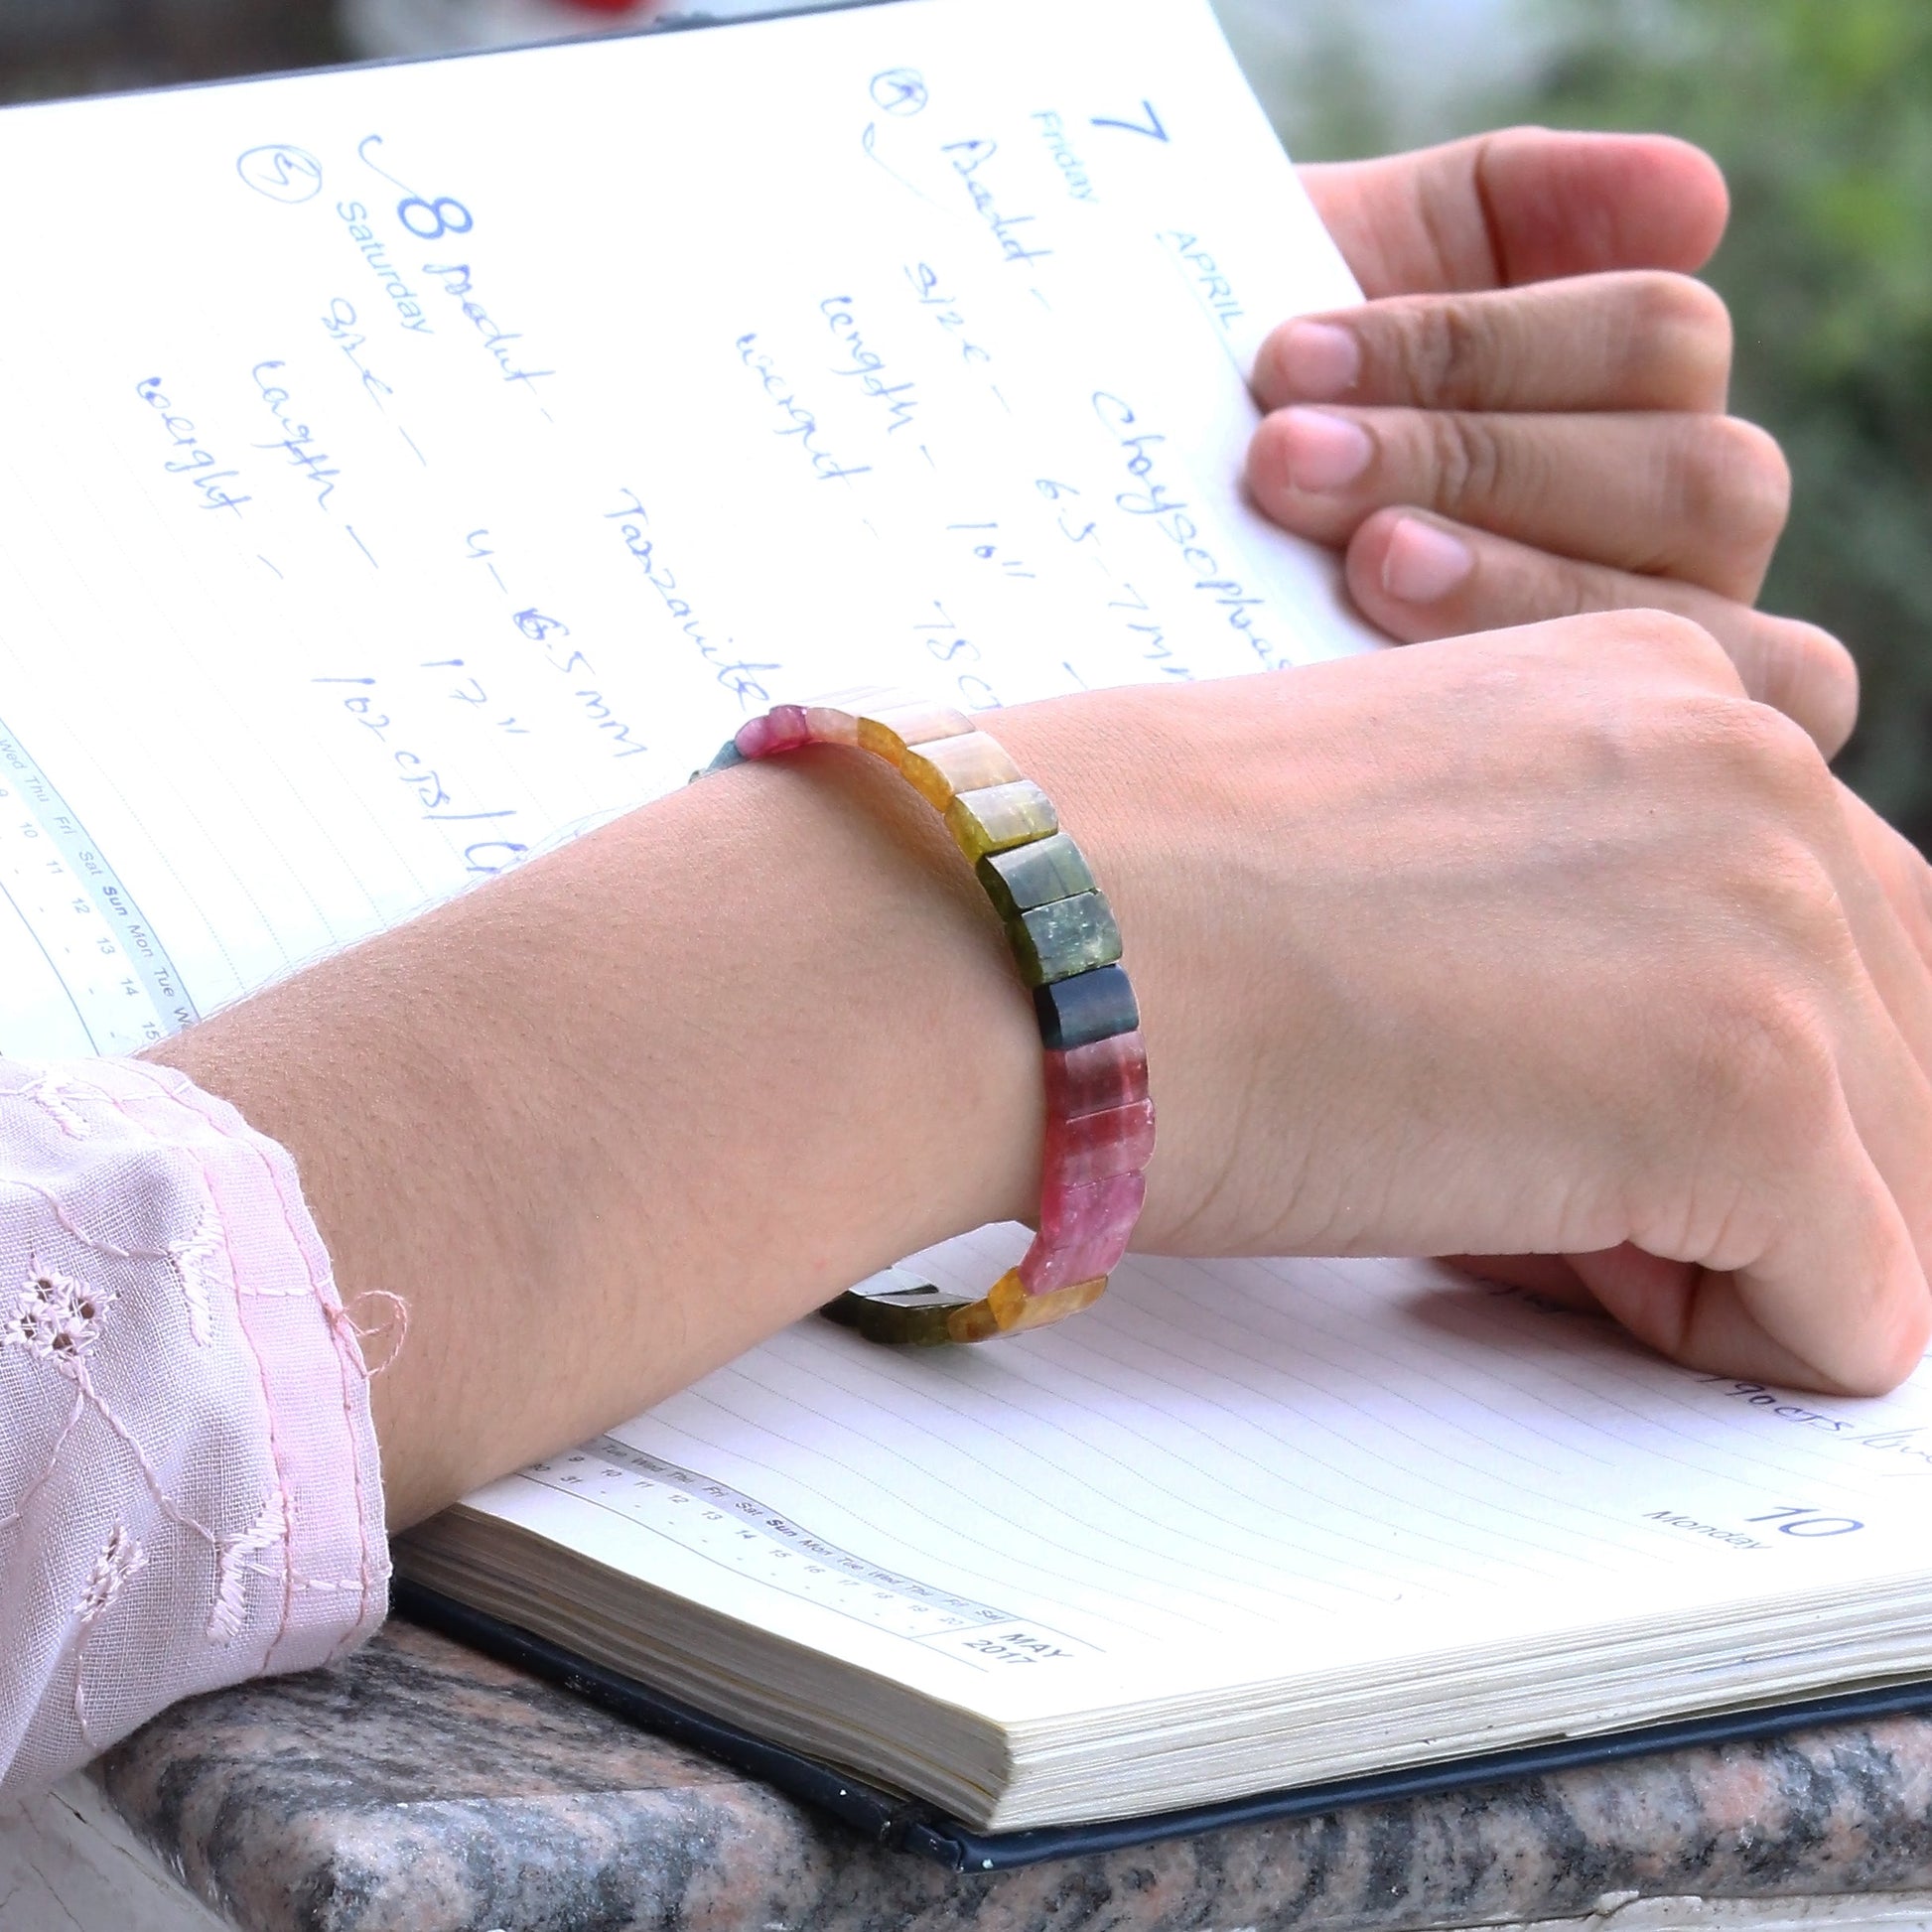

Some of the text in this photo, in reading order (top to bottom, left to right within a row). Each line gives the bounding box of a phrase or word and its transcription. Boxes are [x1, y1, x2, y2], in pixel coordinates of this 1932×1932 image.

[1090, 99, 1171, 144] 7
[1030, 109, 1097, 205] Friday
[397, 197, 474, 239] 8
[337, 202, 435, 334] Saturday
[1168, 229, 1246, 330] APRIL
[0, 740, 28, 769] Wed
[25, 774, 50, 803] Thu
[54, 816, 77, 835] Fri
[78, 851, 103, 876] Sat
[103, 886, 128, 916] Sun
[127, 924, 154, 958] Mon
[154, 967, 175, 998] Tue
[20, 822, 39, 839] 10
[46, 861, 64, 874] 11
[71, 897, 90, 914] 12
[96, 937, 115, 955] 13
[120, 977, 140, 997] 14
[142, 1021, 160, 1039] 15
[560, 1475, 584, 1484] 31
[601, 1468, 622, 1478] 10
[633, 1480, 655, 1489] 11
[667, 1494, 690, 1504] 12
[701, 1510, 723, 1521] 13
[735, 1530, 758, 1540] 14
[768, 1549, 793, 1560] 15
[803, 1565, 826, 1574] 16
[602, 1445, 627, 1458] Tue
[630, 1457, 666, 1473] Wed
[667, 1470, 695, 1484] Thu
[701, 1485, 730, 1499] Fri
[735, 1501, 763, 1517] Sat
[766, 1519, 797, 1538] Sun
[798, 1539, 834, 1557] Mon
[837, 1557, 865, 1572] Tue
[868, 1571, 903, 1585] Wed
[1642, 1510, 1773, 1550] Monday
[1744, 1506, 1864, 1538] 10
[961, 1639, 1038, 1664] 2017
[999, 1633, 1075, 1658] MAY
